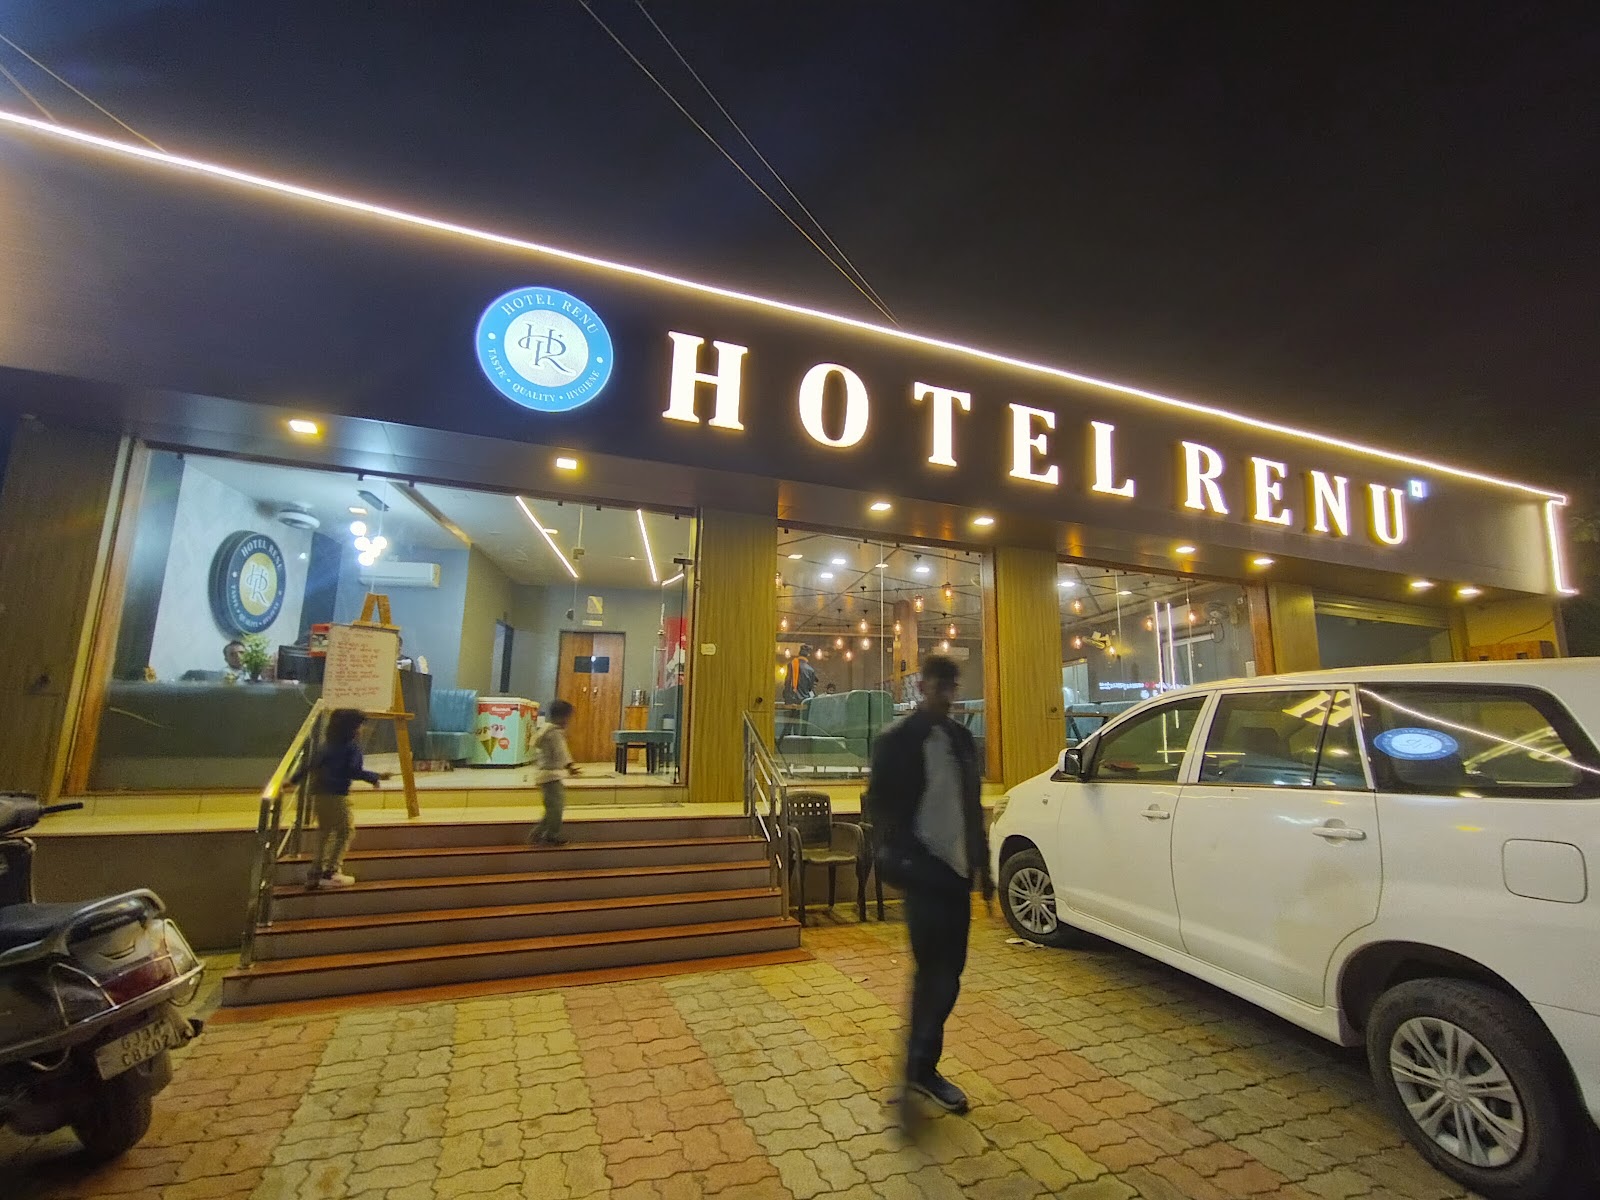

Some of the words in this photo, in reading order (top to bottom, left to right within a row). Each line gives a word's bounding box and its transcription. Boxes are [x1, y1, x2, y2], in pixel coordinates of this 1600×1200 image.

[502, 293, 555, 316] HOTEL
[562, 300, 598, 334] RENU
[487, 347, 508, 379] TASTE
[511, 382, 557, 403] QUALITY
[566, 370, 599, 400] HYGIENE
[662, 330, 1135, 499] HOTEL
[1180, 440, 1408, 546] RENU
[241, 539, 267, 557] HOTEL
